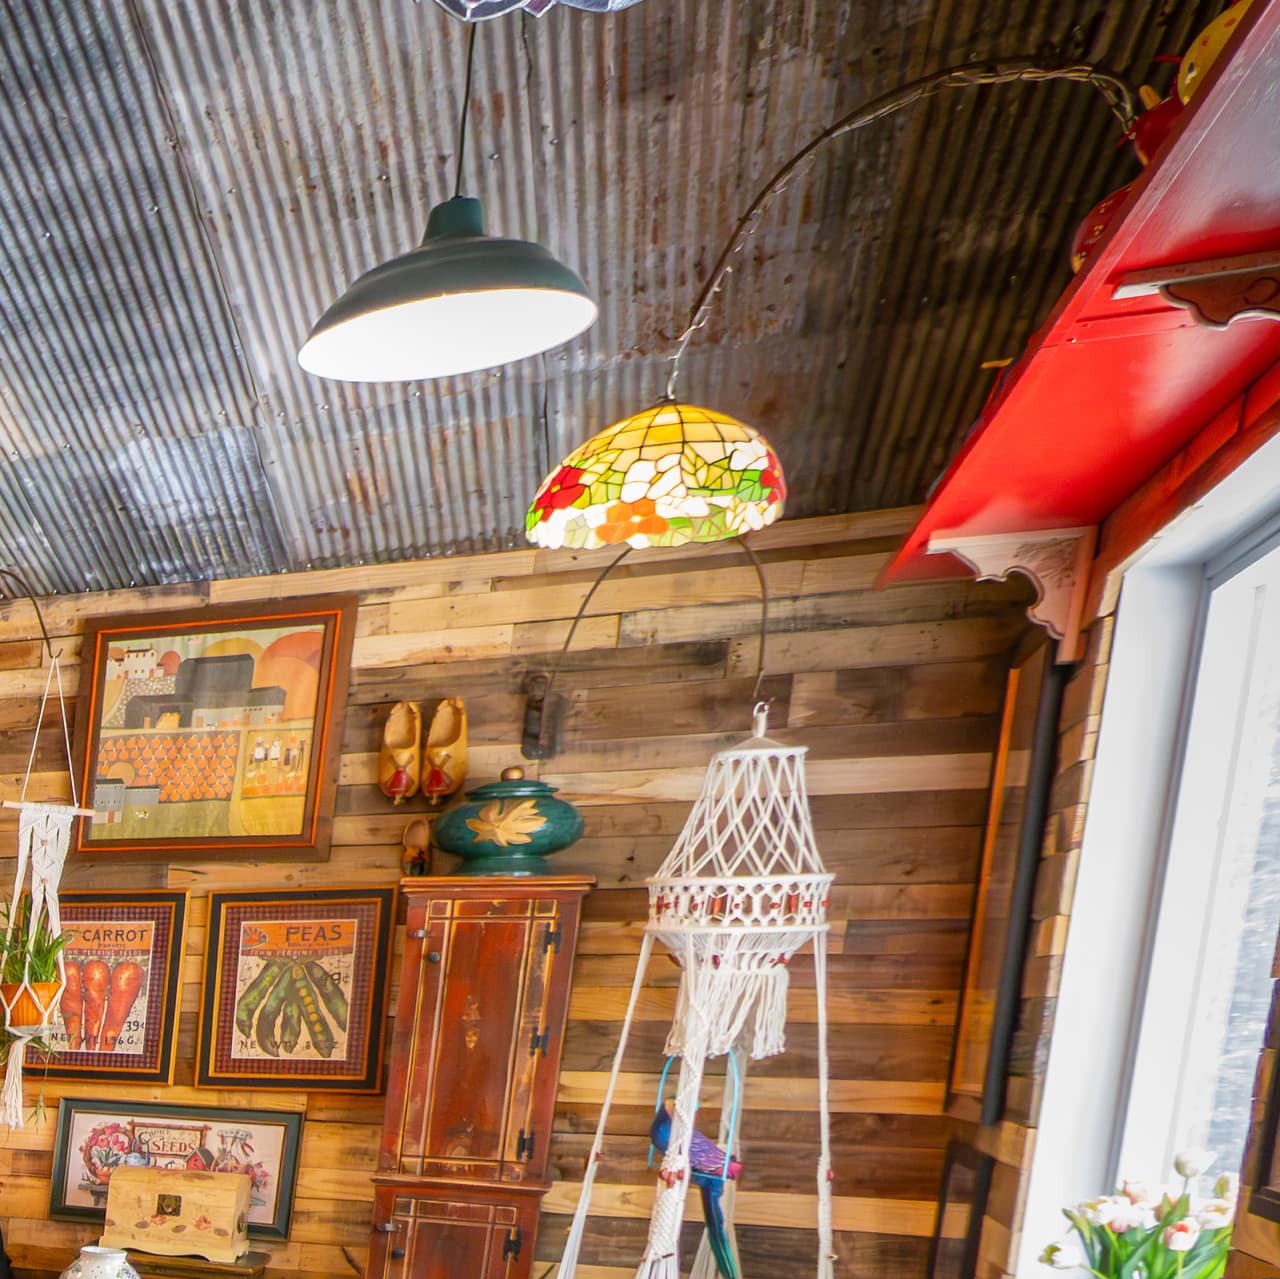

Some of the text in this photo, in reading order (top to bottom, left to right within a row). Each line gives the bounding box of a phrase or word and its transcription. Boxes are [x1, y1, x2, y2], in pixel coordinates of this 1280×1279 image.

[82, 928, 150, 942] CARROT
[285, 924, 342, 943] PEAS
[152, 1140, 195, 1153] SEEDS
